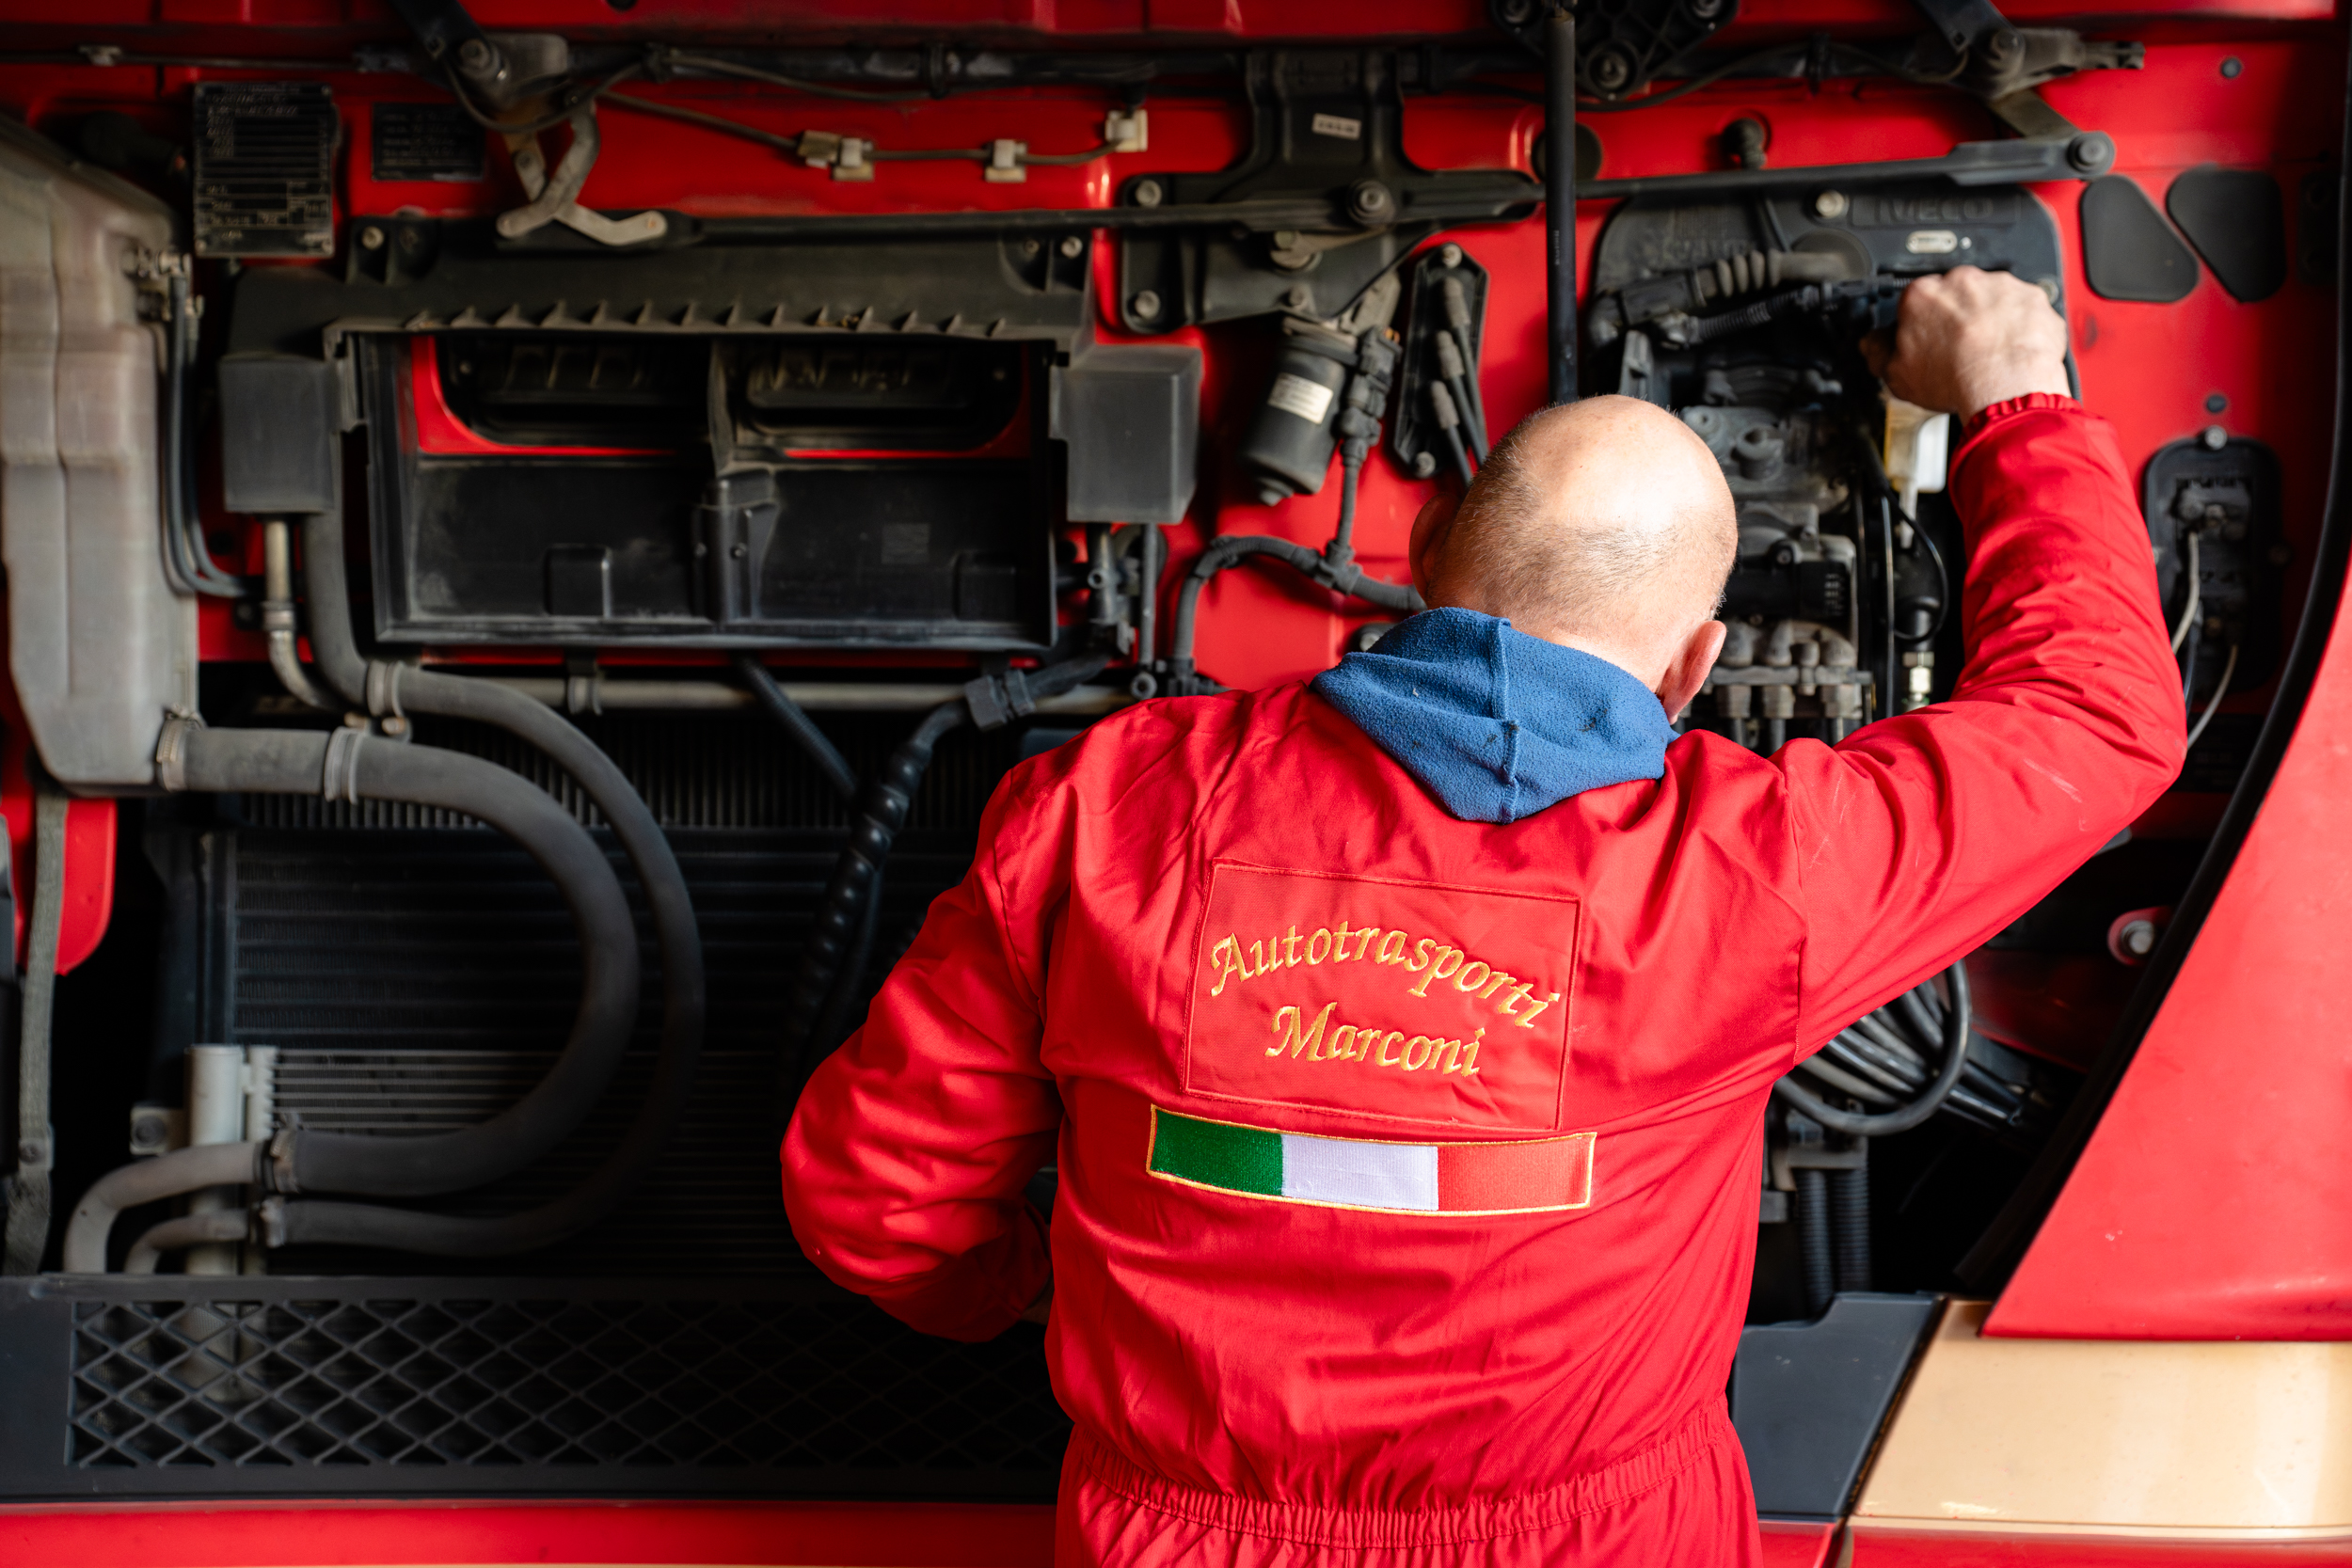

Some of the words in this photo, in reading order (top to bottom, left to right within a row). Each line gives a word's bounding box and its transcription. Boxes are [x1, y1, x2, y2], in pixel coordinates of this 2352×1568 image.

[1875, 197, 1995, 220] IVECO
[1210, 921, 1560, 1029] Autotrasporti
[1264, 1002, 1486, 1077] Marconi
